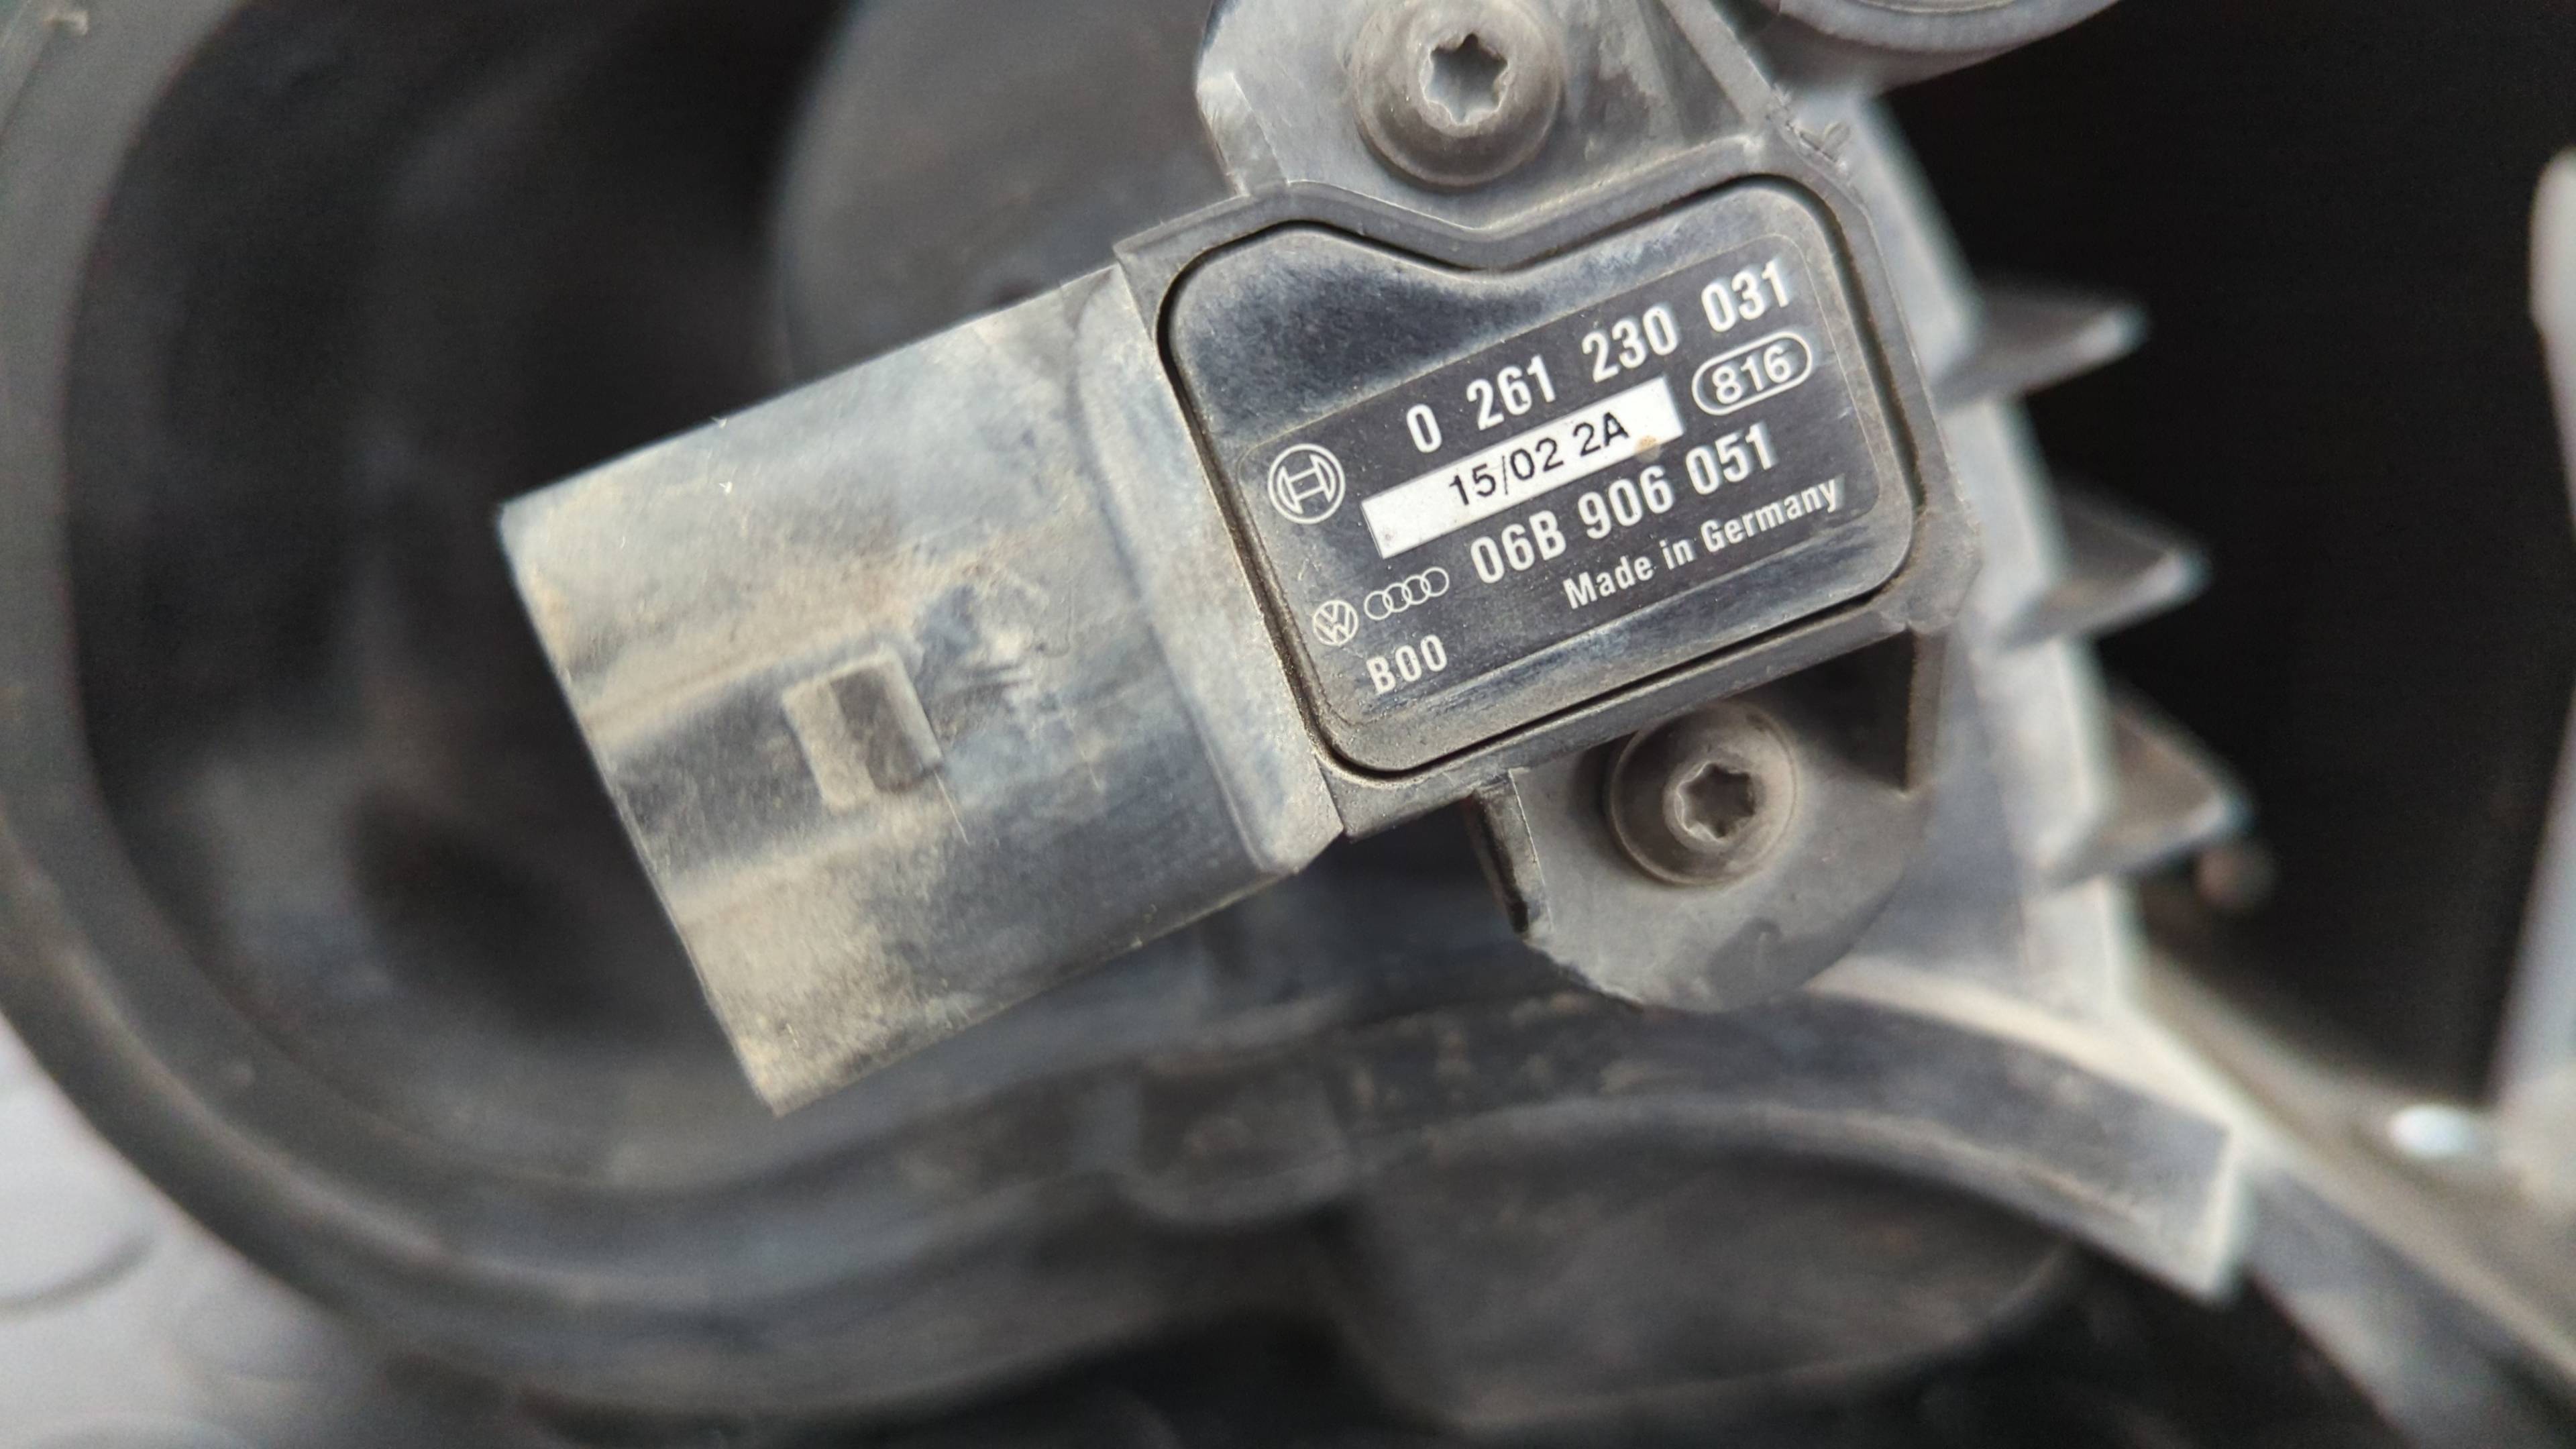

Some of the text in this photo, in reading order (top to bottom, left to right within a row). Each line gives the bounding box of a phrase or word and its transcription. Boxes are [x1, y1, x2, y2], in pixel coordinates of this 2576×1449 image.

[1406, 261, 1791, 454] 0 261 230 031
[1711, 344, 1793, 404] 816
[1449, 413, 1629, 506] 15/02 2A
[1470, 423, 1779, 584] 06B 906 051
[1563, 476, 1839, 609] Made in Germany
[1366, 635, 1448, 695] B00
